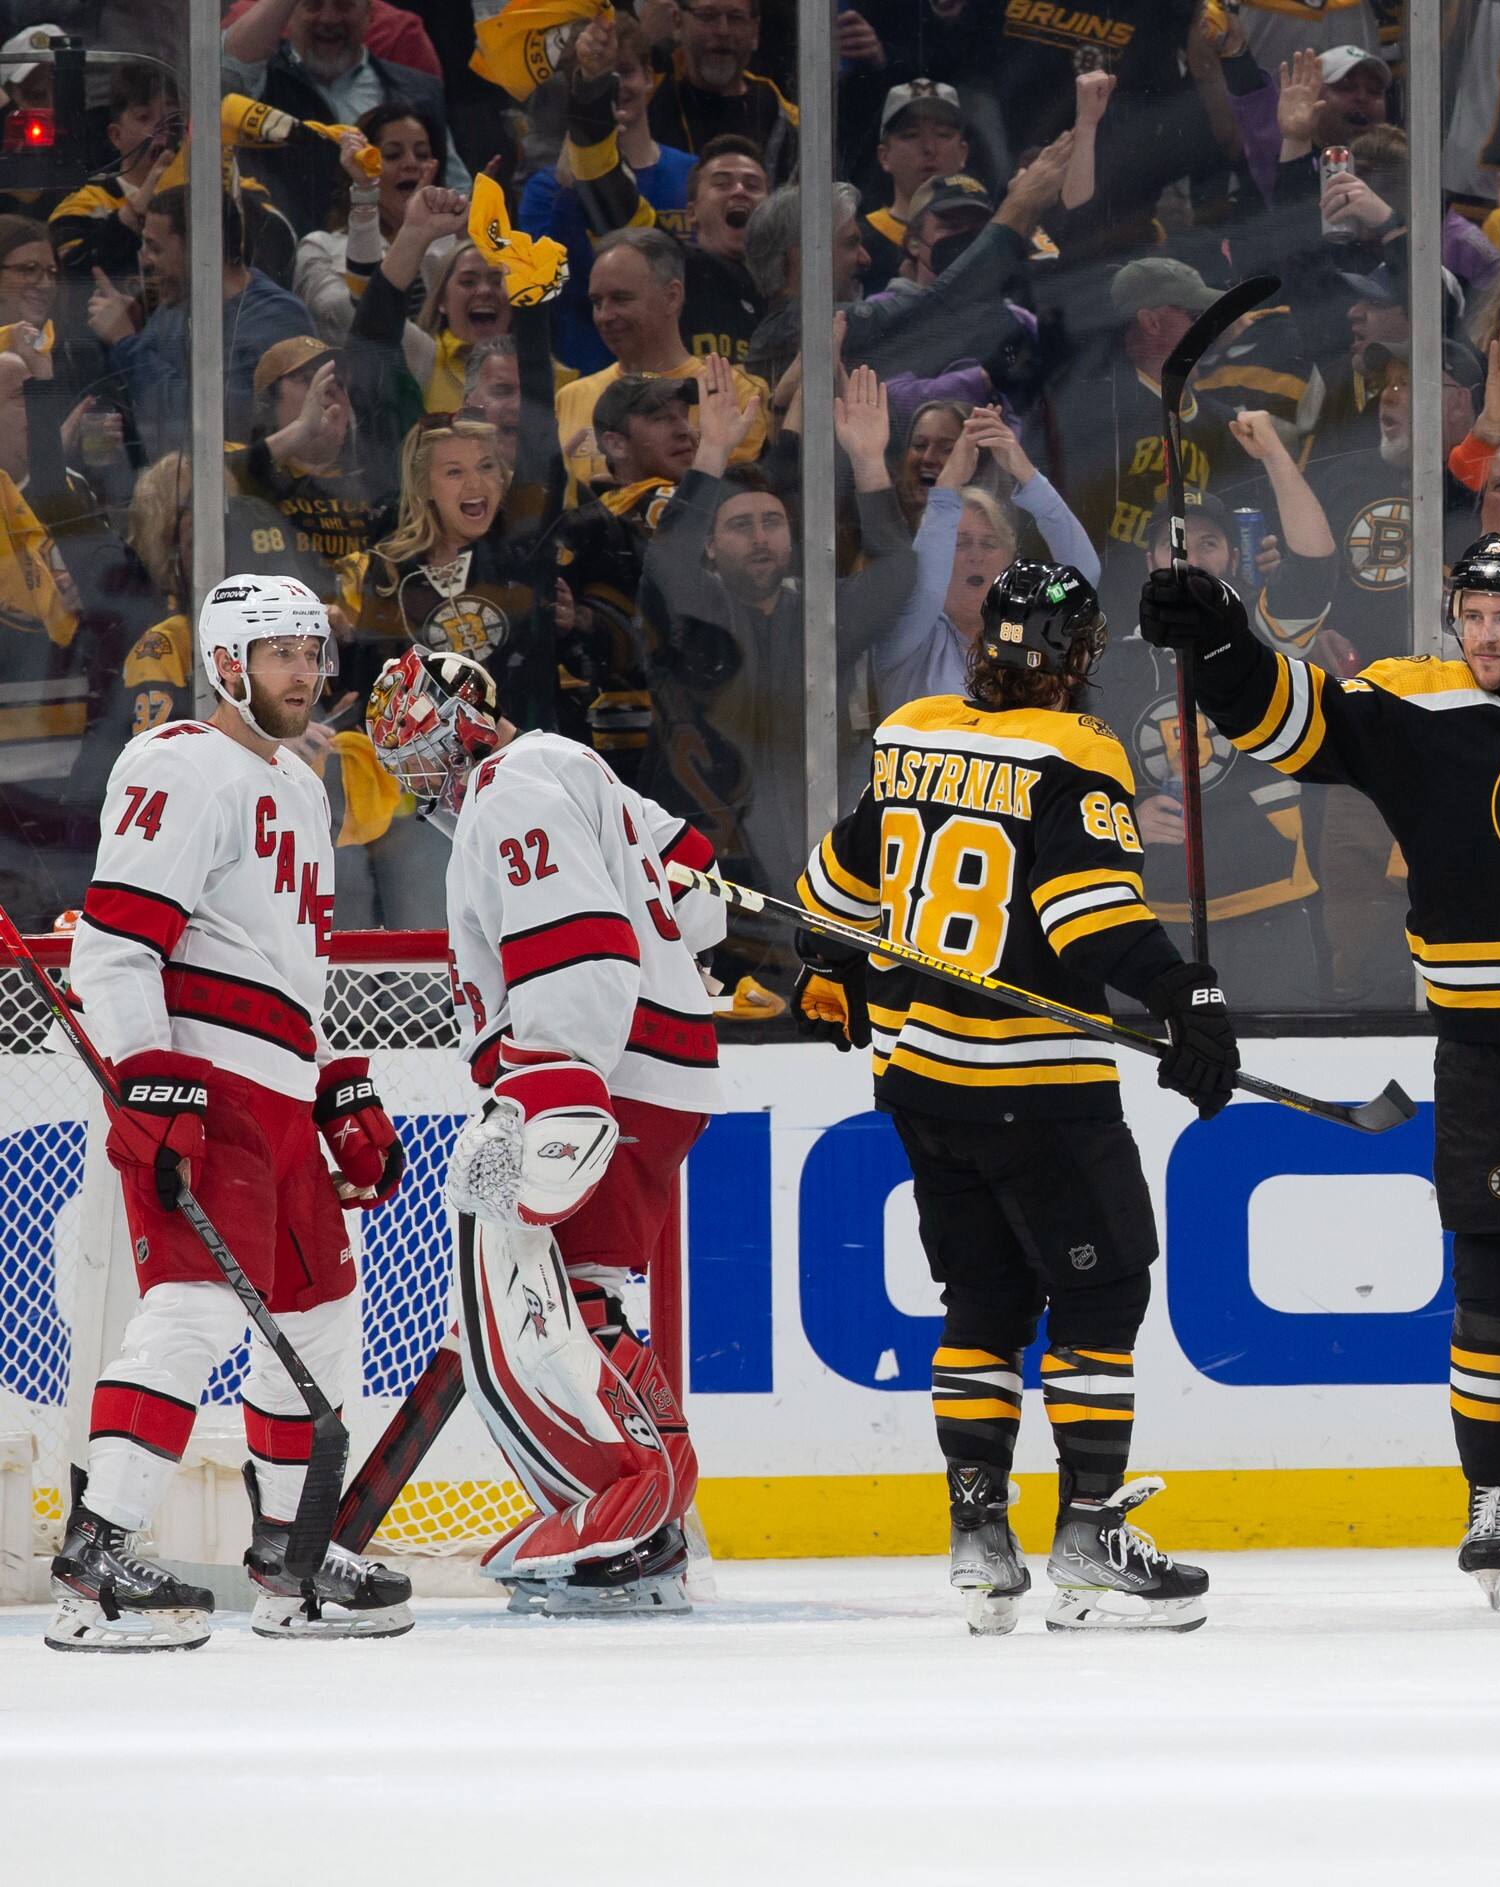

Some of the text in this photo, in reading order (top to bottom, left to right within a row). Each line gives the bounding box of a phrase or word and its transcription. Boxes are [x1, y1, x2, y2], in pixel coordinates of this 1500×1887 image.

[1005, 0, 1136, 46] BRUINS
[252, 526, 286, 554] 88
[214, 589, 248, 600] Lenovo
[1000, 621, 1024, 644] 88
[114, 786, 169, 842] 74
[1080, 791, 1145, 853] 88
[255, 795, 336, 958] CANE
[500, 828, 560, 888] 32
[868, 806, 1017, 978] 88
[128, 1083, 207, 1107] BAUE
